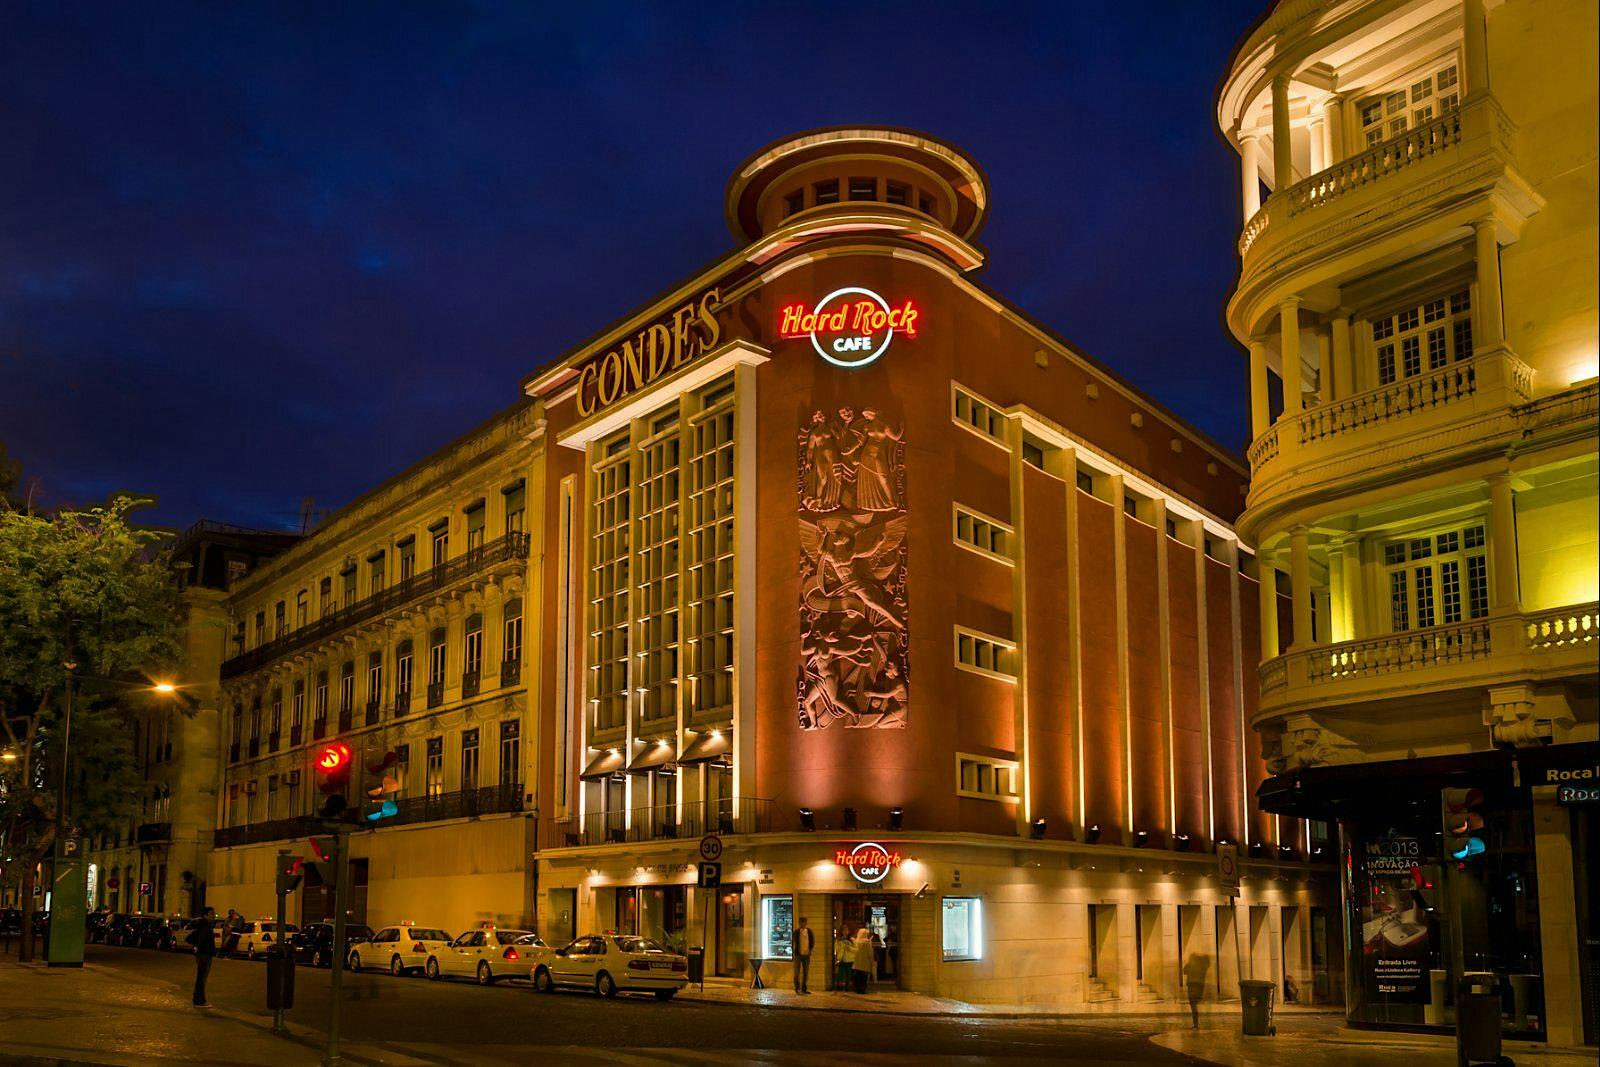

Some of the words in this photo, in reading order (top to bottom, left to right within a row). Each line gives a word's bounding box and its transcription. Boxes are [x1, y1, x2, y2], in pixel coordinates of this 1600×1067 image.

[782, 304, 849, 333] Hard
[852, 301, 918, 335] Rock
[576, 287, 721, 418] CONDES
[833, 337, 871, 352] CAFE
[1546, 769, 1593, 782] Roca
[703, 843, 719, 854] 30
[836, 851, 868, 865] Hard
[870, 851, 901, 869] Rock
[1367, 859, 1419, 870] INOVAÇÃO
[703, 865, 717, 886] P
